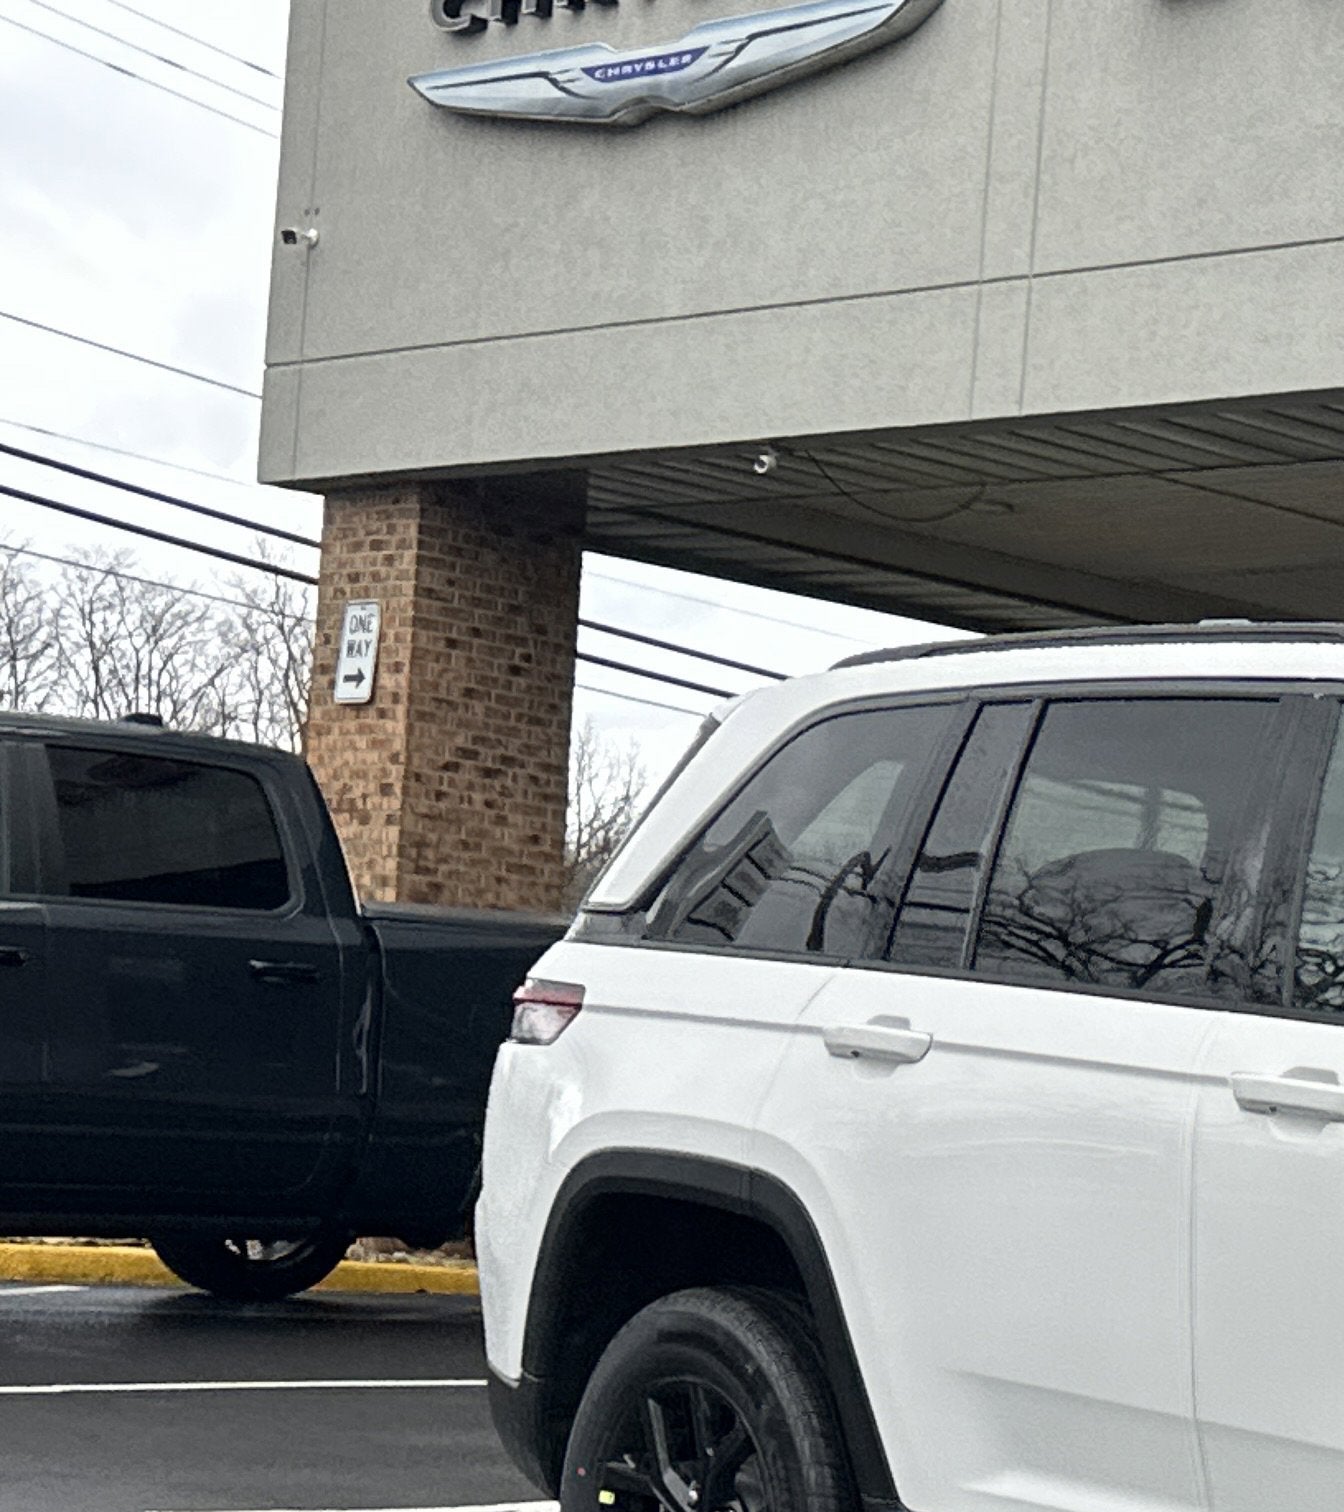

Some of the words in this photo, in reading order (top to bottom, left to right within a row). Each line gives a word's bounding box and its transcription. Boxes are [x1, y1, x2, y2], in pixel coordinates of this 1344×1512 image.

[594, 53, 693, 79] CHRYSLER
[349, 613, 376, 634] ONE
[345, 639, 373, 658] WAY
